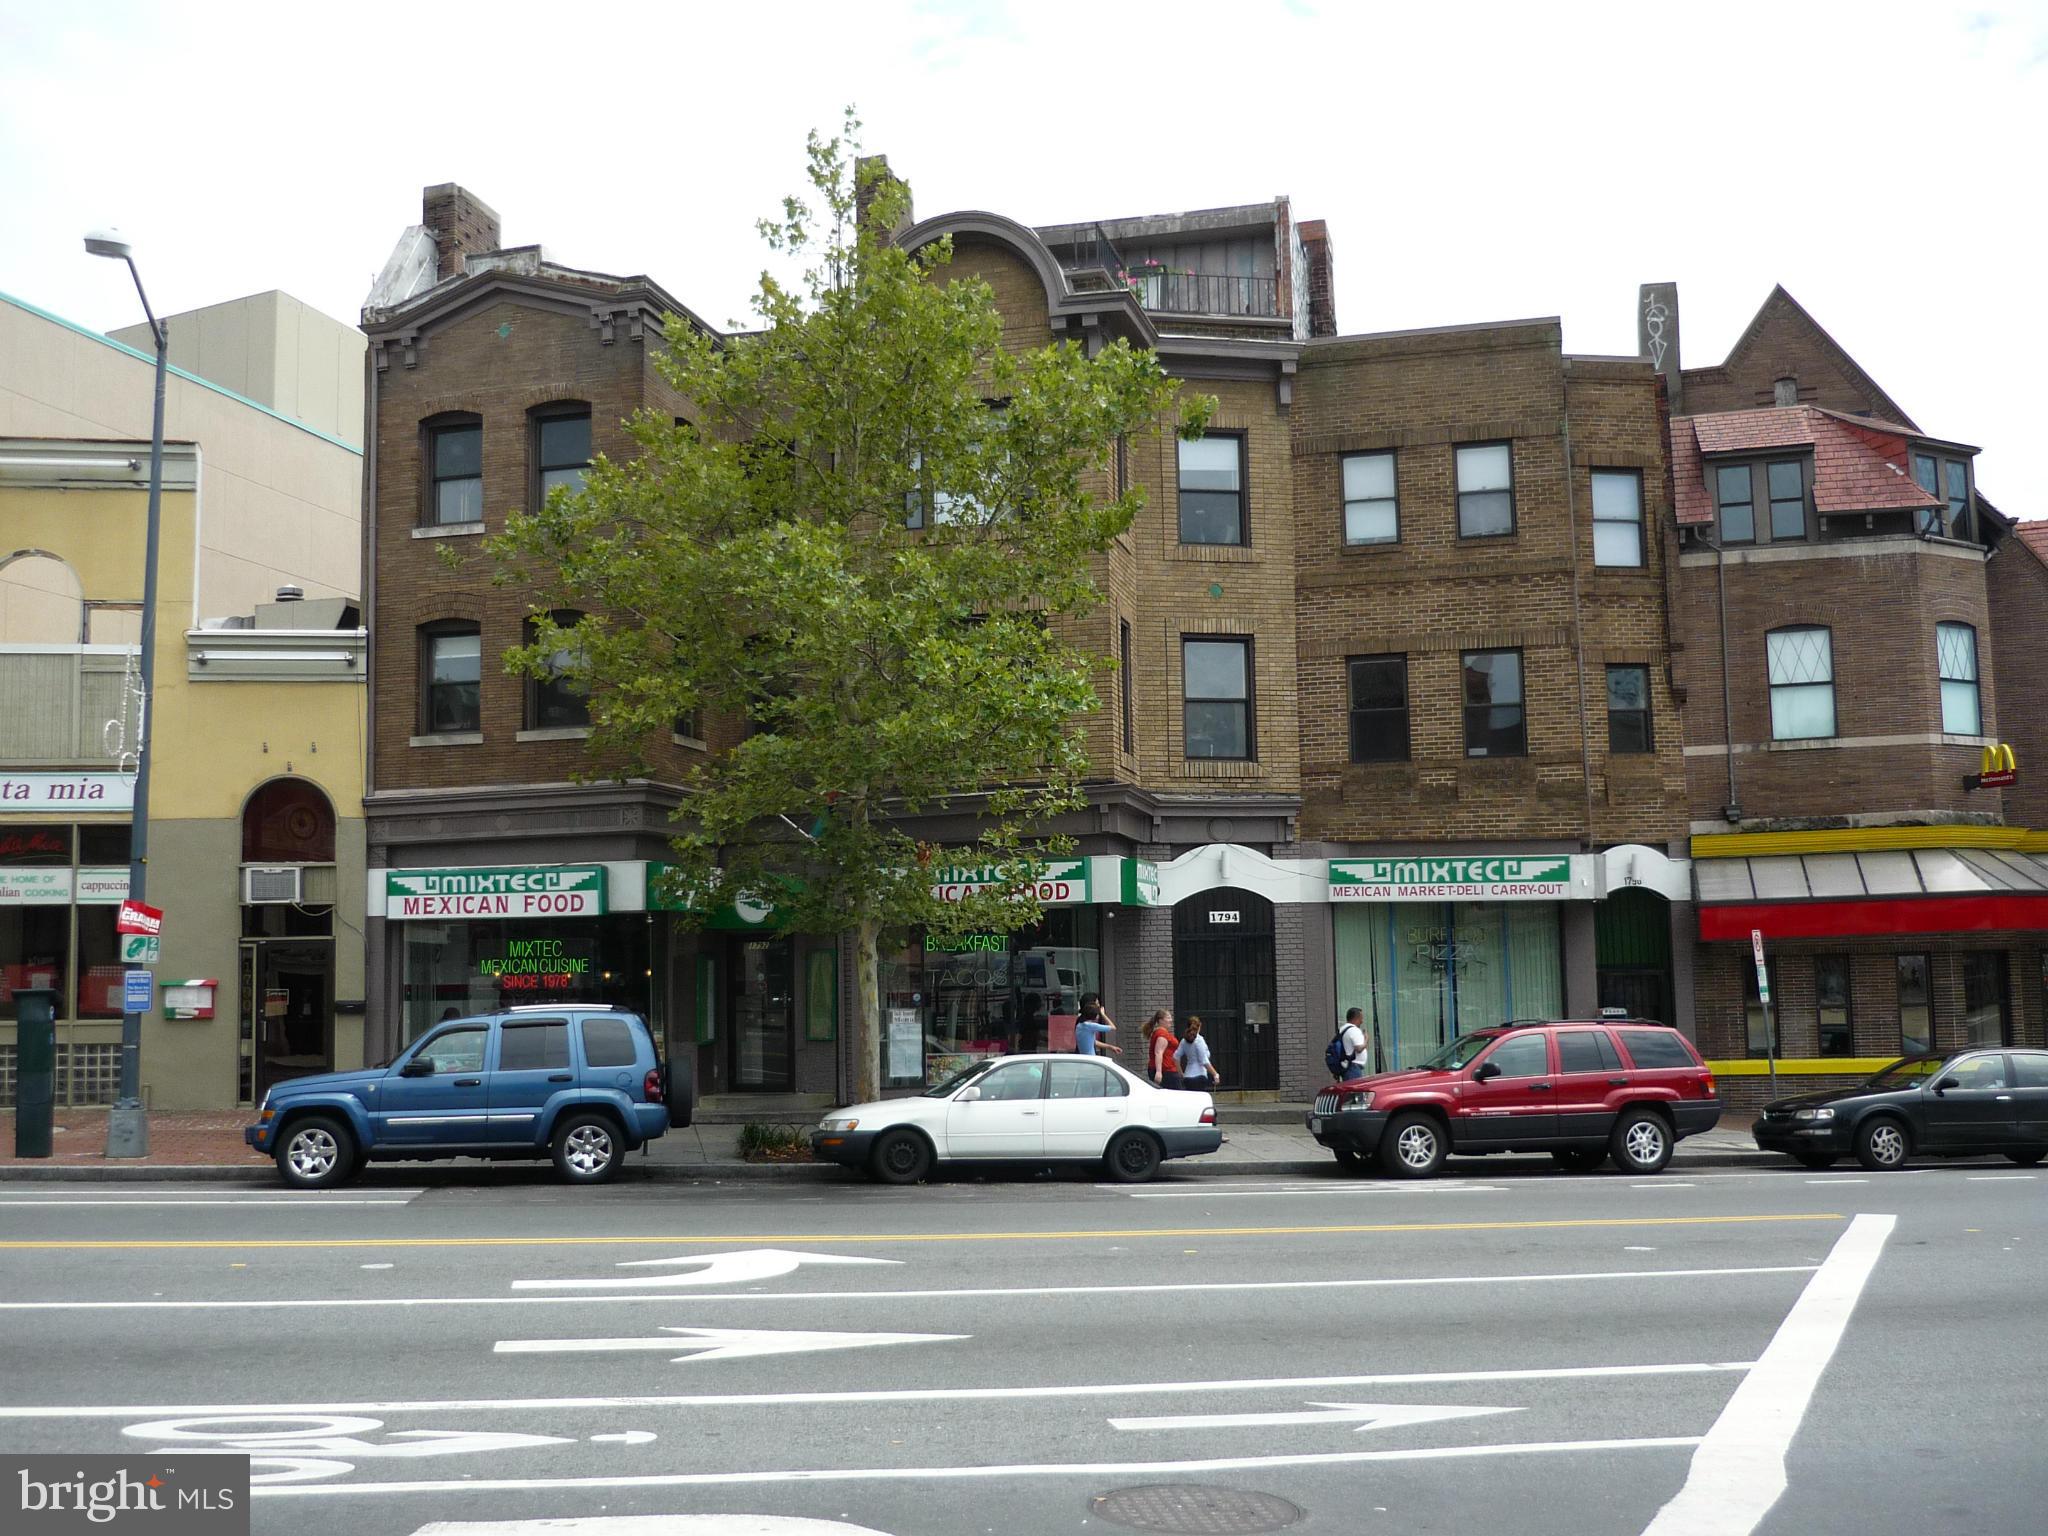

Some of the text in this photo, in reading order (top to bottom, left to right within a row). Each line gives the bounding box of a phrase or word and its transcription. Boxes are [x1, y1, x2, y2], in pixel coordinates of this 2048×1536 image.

[3, 778, 104, 800] ta mia
[1394, 861, 1500, 883] MIXTEC
[442, 873, 544, 894] MIXTEC
[1332, 883, 1563, 897] MEXICAN MARKET-DELI CARRY-OUT
[24, 889, 69, 897] COOKING
[403, 893, 585, 915] MEXICAN FOOD
[1210, 913, 1238, 921] 1794
[149, 938, 159, 948] 2
[509, 940, 563, 957] MIXTEC
[481, 958, 590, 974] MEXICAN CUISINE
[502, 974, 569, 989] SINCE 1978
